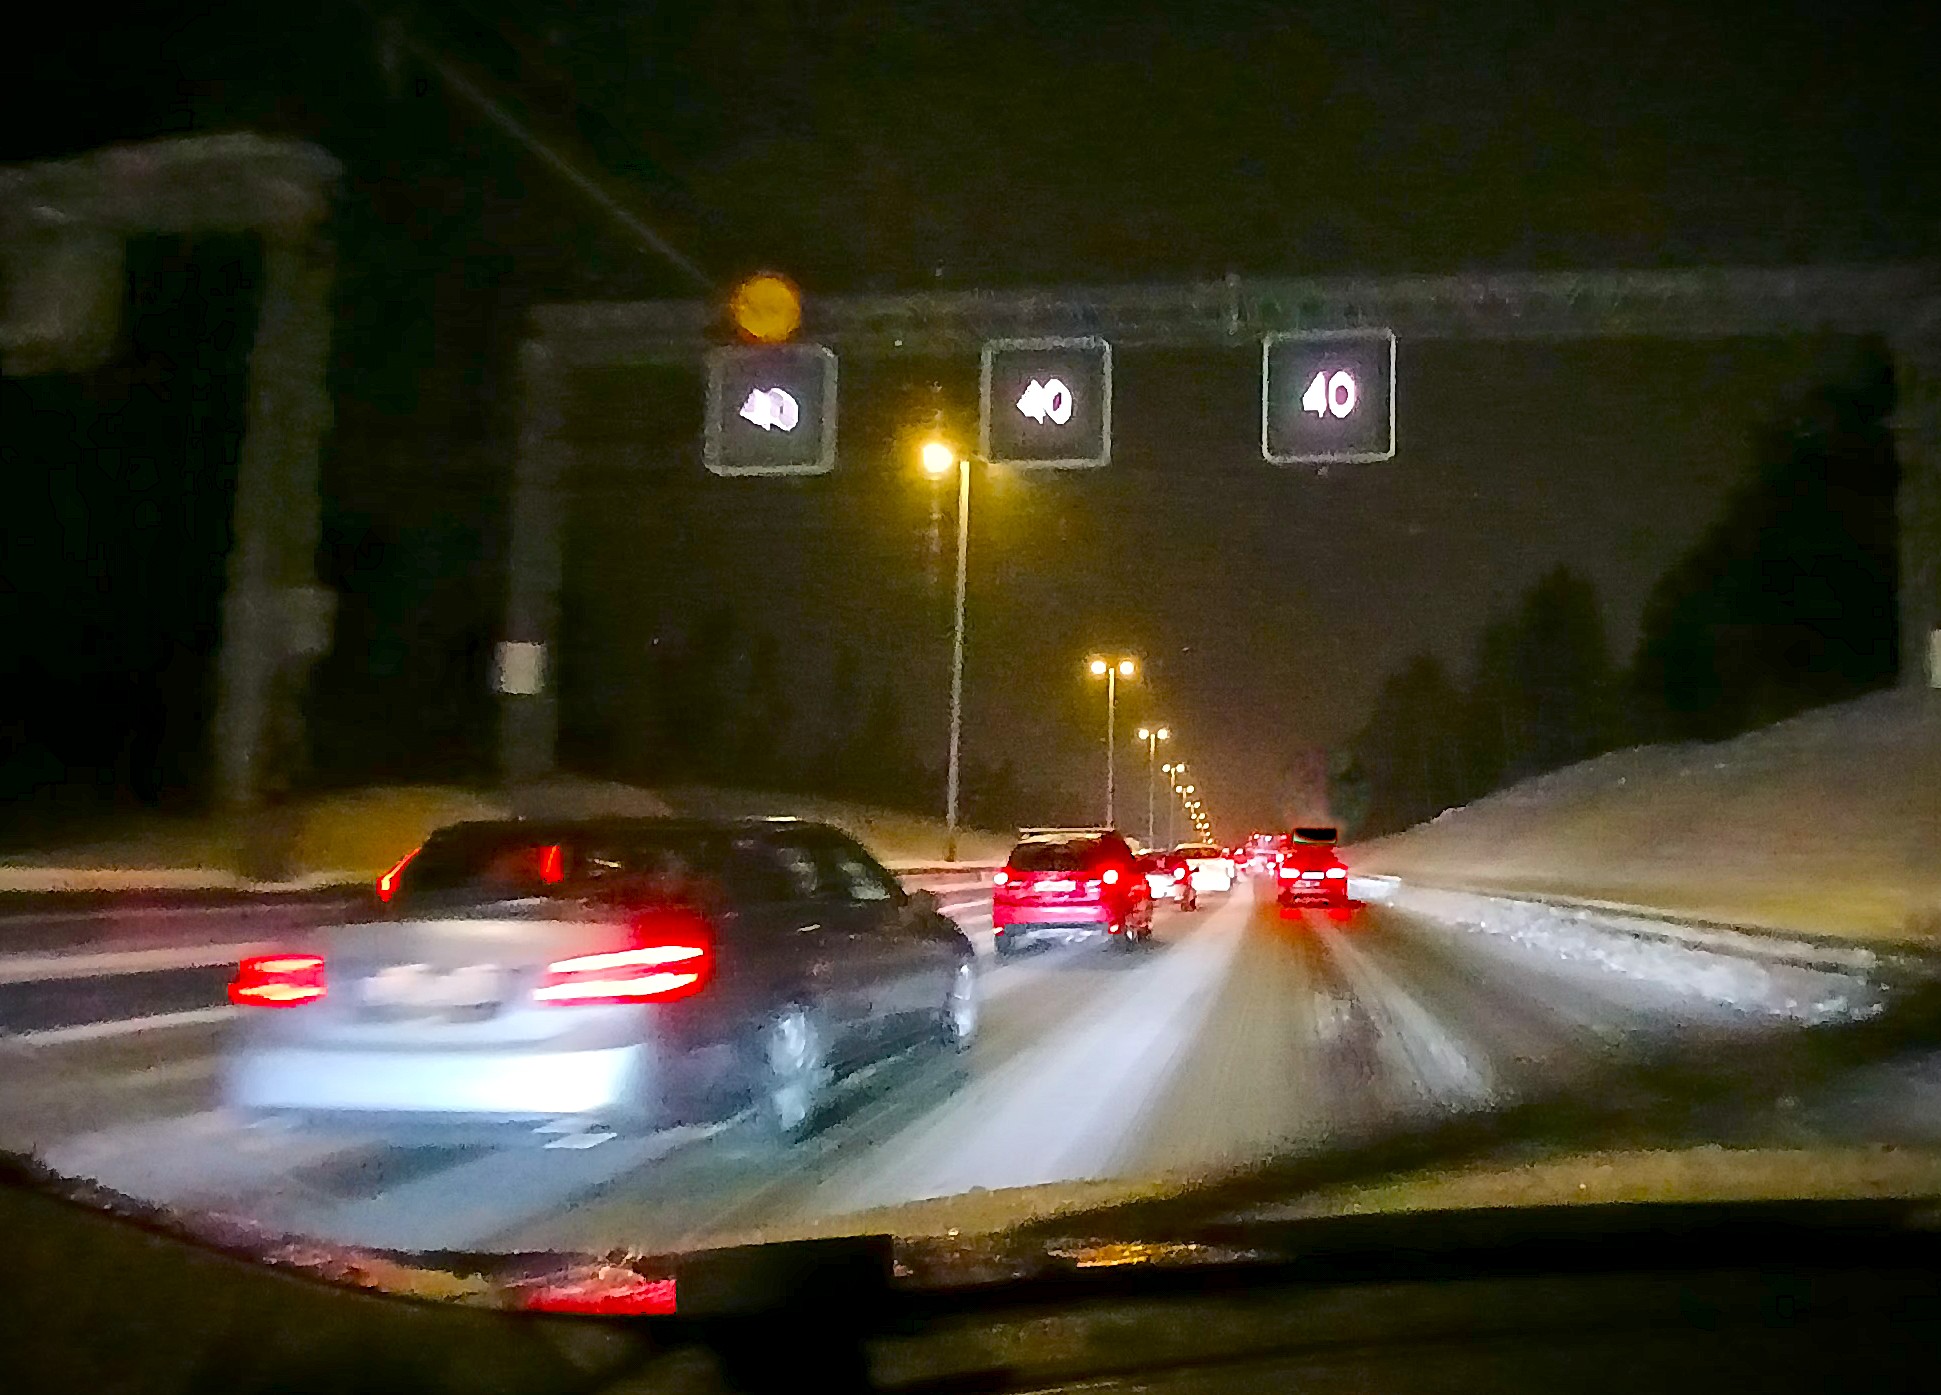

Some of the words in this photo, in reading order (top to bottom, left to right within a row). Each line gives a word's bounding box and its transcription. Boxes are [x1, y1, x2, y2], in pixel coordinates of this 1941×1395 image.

[738, 386, 800, 432] 40
[1015, 377, 1074, 425] 40
[1302, 369, 1357, 418] 40
